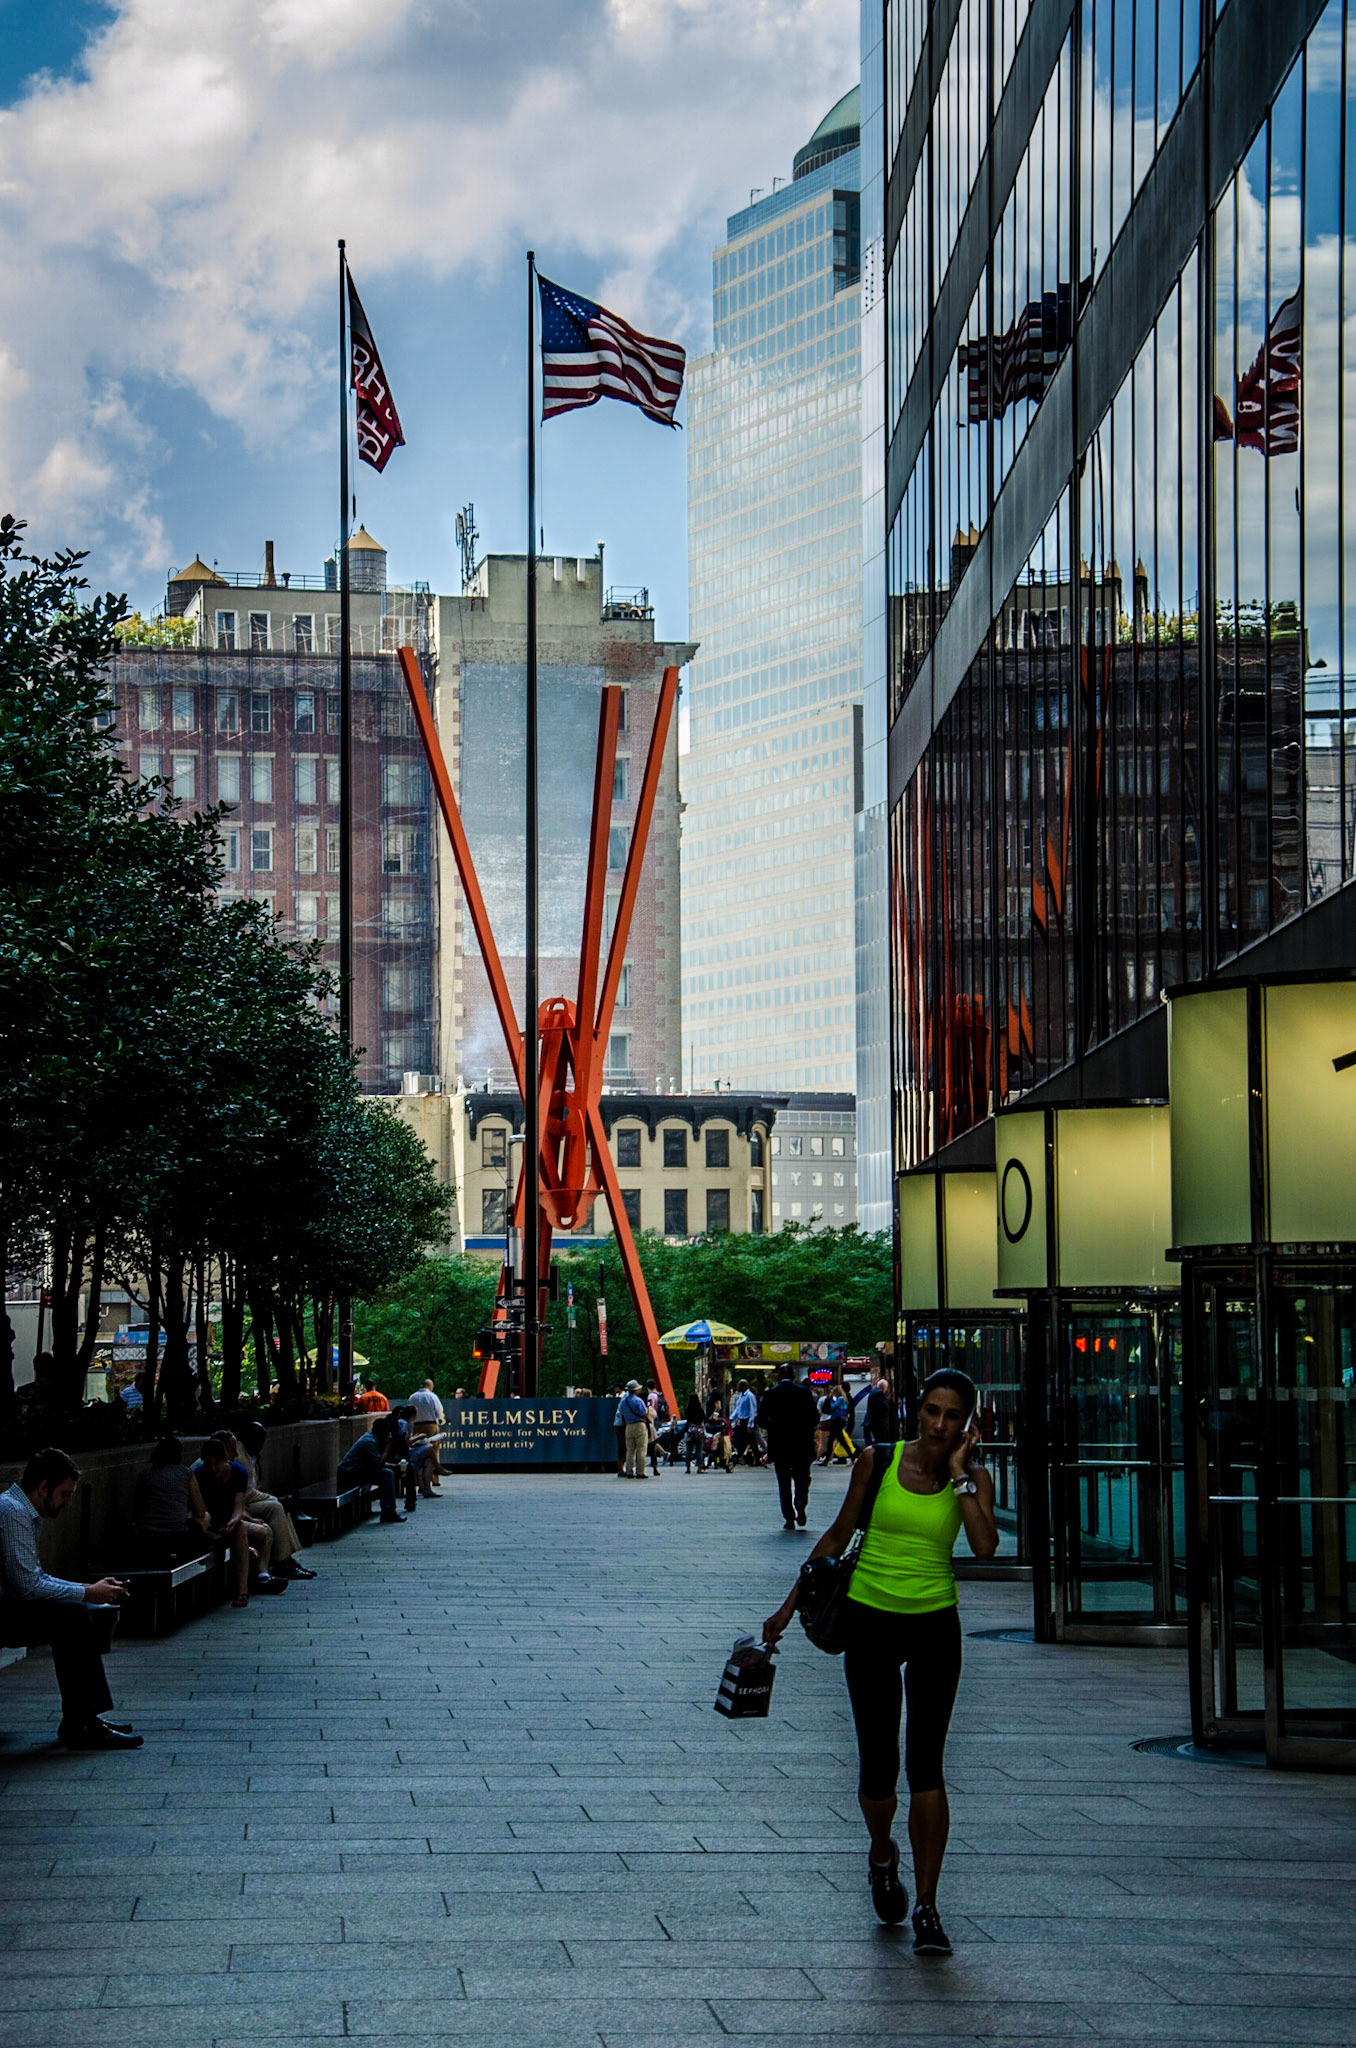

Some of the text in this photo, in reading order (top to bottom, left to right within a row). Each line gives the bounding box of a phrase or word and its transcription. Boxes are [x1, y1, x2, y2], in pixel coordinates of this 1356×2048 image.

[809, 1371, 832, 1381] OPEN
[460, 1409, 579, 1426] HELMSLEY
[468, 1430, 487, 1438] and
[491, 1429, 513, 1437] love
[517, 1428, 533, 1437] for
[536, 1428, 559, 1437] New
[562, 1428, 587, 1437] York
[460, 1440, 480, 1449] this
[484, 1440, 510, 1450] great
[514, 1440, 535, 1449] city
